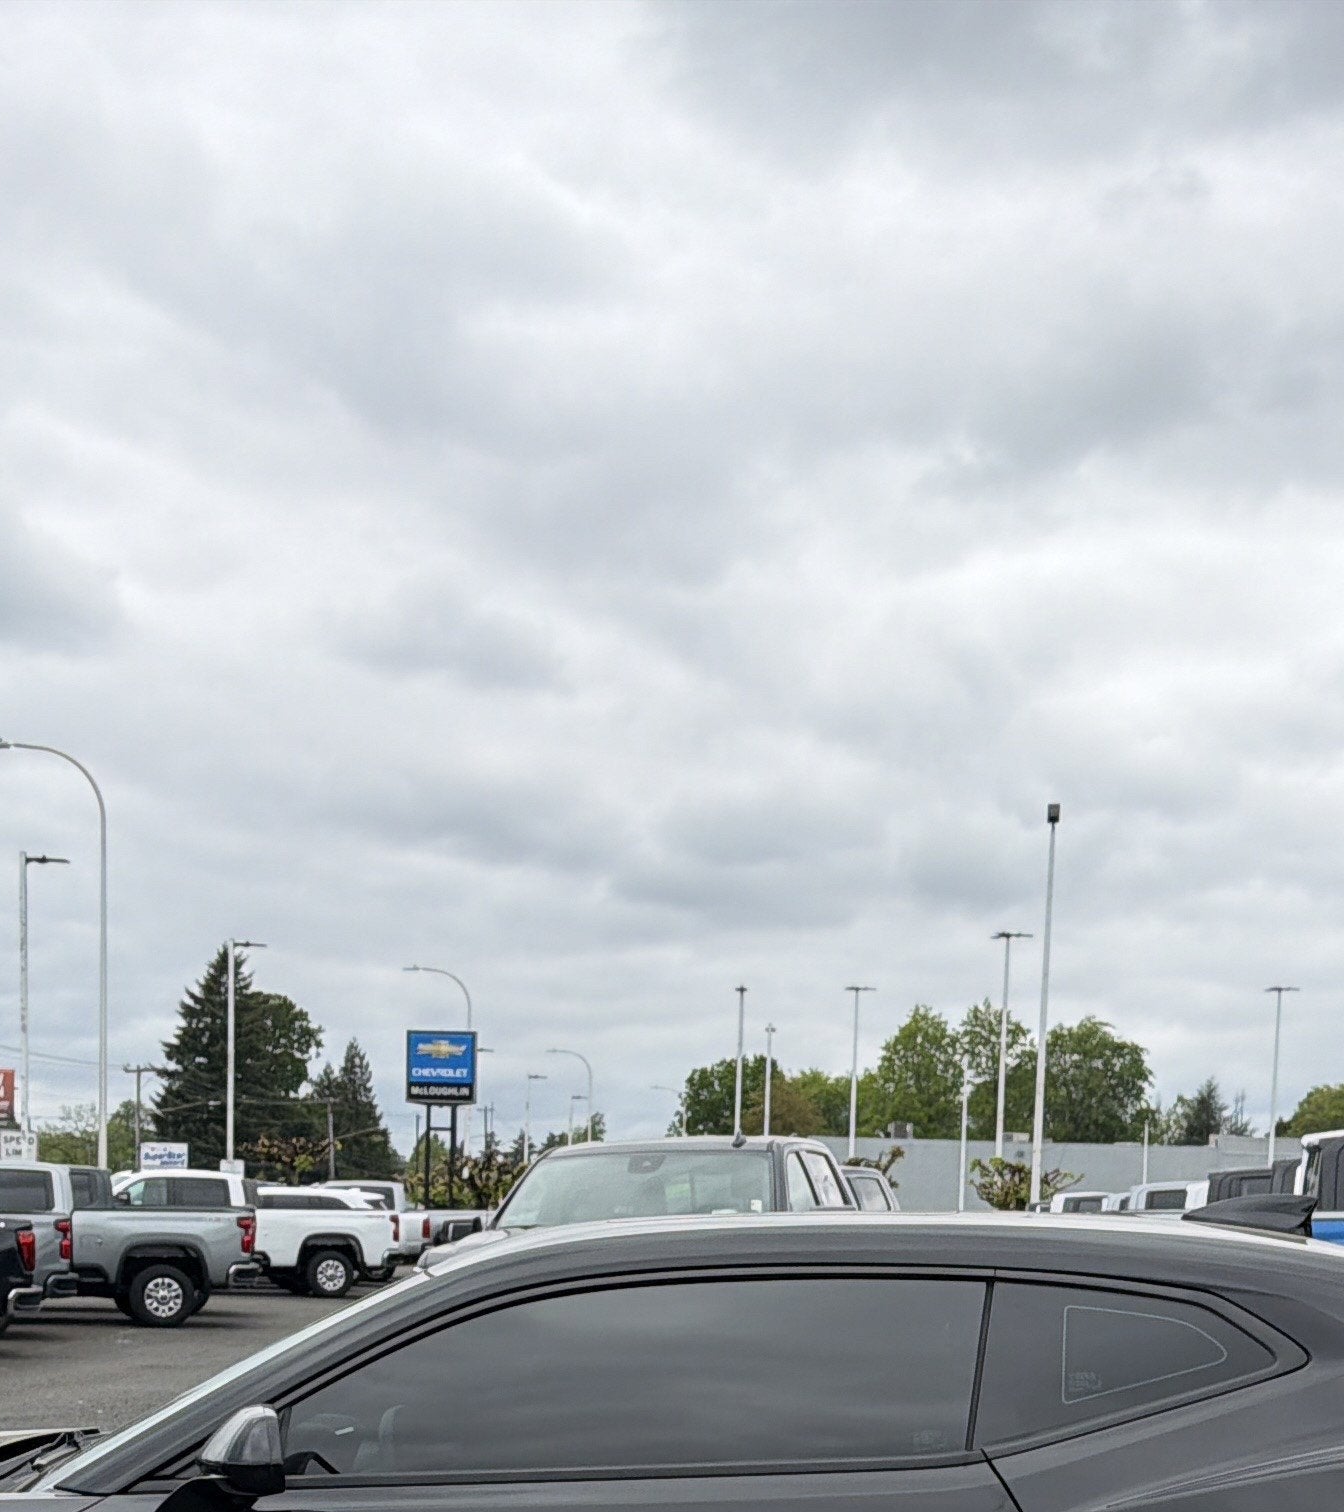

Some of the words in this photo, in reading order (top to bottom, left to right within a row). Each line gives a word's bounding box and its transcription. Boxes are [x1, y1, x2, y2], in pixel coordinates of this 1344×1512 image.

[411, 1067, 468, 1077] CHEVROLET
[410, 1085, 470, 1096] McLOUGHLIN
[3, 1135, 35, 1145] SPED
[5, 1147, 33, 1156] LIM
